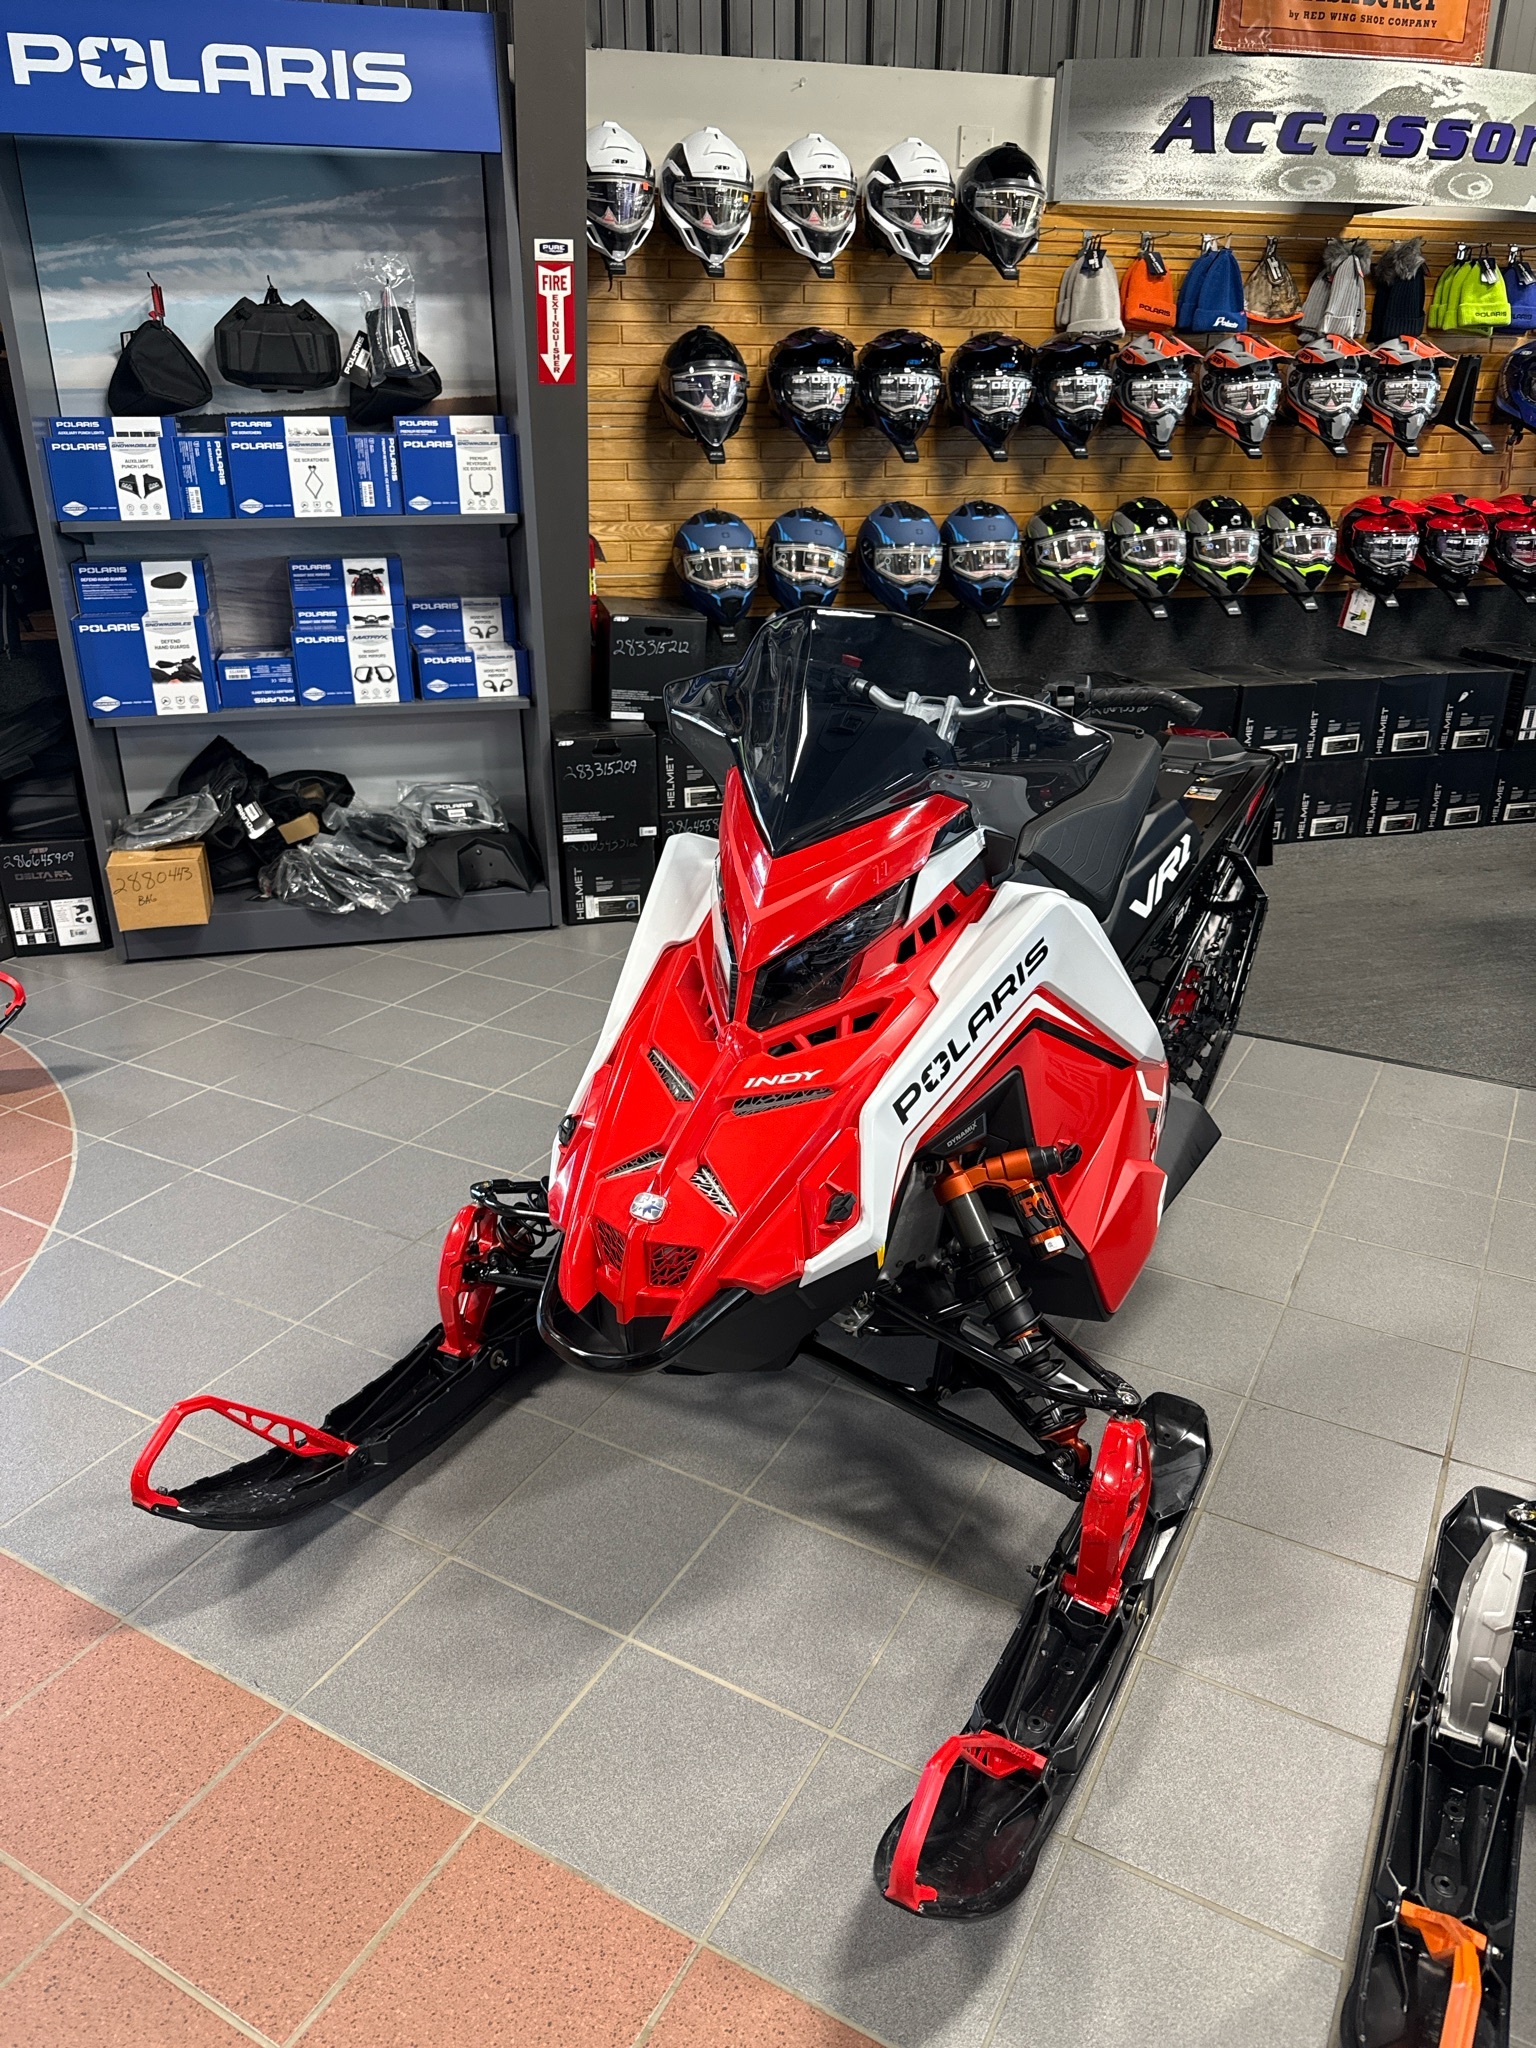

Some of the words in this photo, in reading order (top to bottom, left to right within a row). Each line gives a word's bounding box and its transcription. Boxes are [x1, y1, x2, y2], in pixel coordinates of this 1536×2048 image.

[1288, 10, 1300, 20] by
[1303, 11, 1326, 20] RED
[1330, 12, 1356, 22] WING
[1360, 14, 1385, 25] SHOE
[1388, 16, 1438, 28] COMPANY
[6, 32, 412, 102] POLARIS
[542, 275, 567, 291] FIRE
[1139, 303, 1171, 317] POLARIS
[552, 294, 560, 373] EXTINGUISHER
[343, 336, 364, 375] POLARIS
[396, 329, 417, 372] POLARIS
[51, 443, 107, 451] POLARIS
[231, 442, 284, 450] POLARIS
[388, 438, 398, 481] POLARIS
[403, 441, 453, 449] POLARIS
[214, 441, 226, 485] POLARIS
[79, 623, 140, 633] POLARIS
[298, 610, 338, 618] POLARIS
[296, 635, 346, 644] POLARIS
[613, 638, 690, 656] 283315212
[424, 656, 472, 664] POLARIS
[1305, 711, 1319, 759] HELMET
[1375, 707, 1389, 755] HELMET
[1439, 703, 1454, 750] HELMET
[564, 759, 637, 780] 283315209
[666, 755, 675, 808] HELMET
[435, 801, 473, 810] POLARIS
[1365, 789, 1380, 834] HELMET
[1428, 783, 1442, 828] HELMET
[1490, 778, 1506, 823] HELMET
[1297, 793, 1311, 839] HELMET
[15, 872, 53, 881] DELTA
[113, 866, 193, 895] 2880443
[573, 867, 585, 920] HELMET
[892, 936, 1049, 1126] POLARIS
[743, 1069, 824, 1089] INDY
[946, 1119, 978, 1147] DYNAMIX
